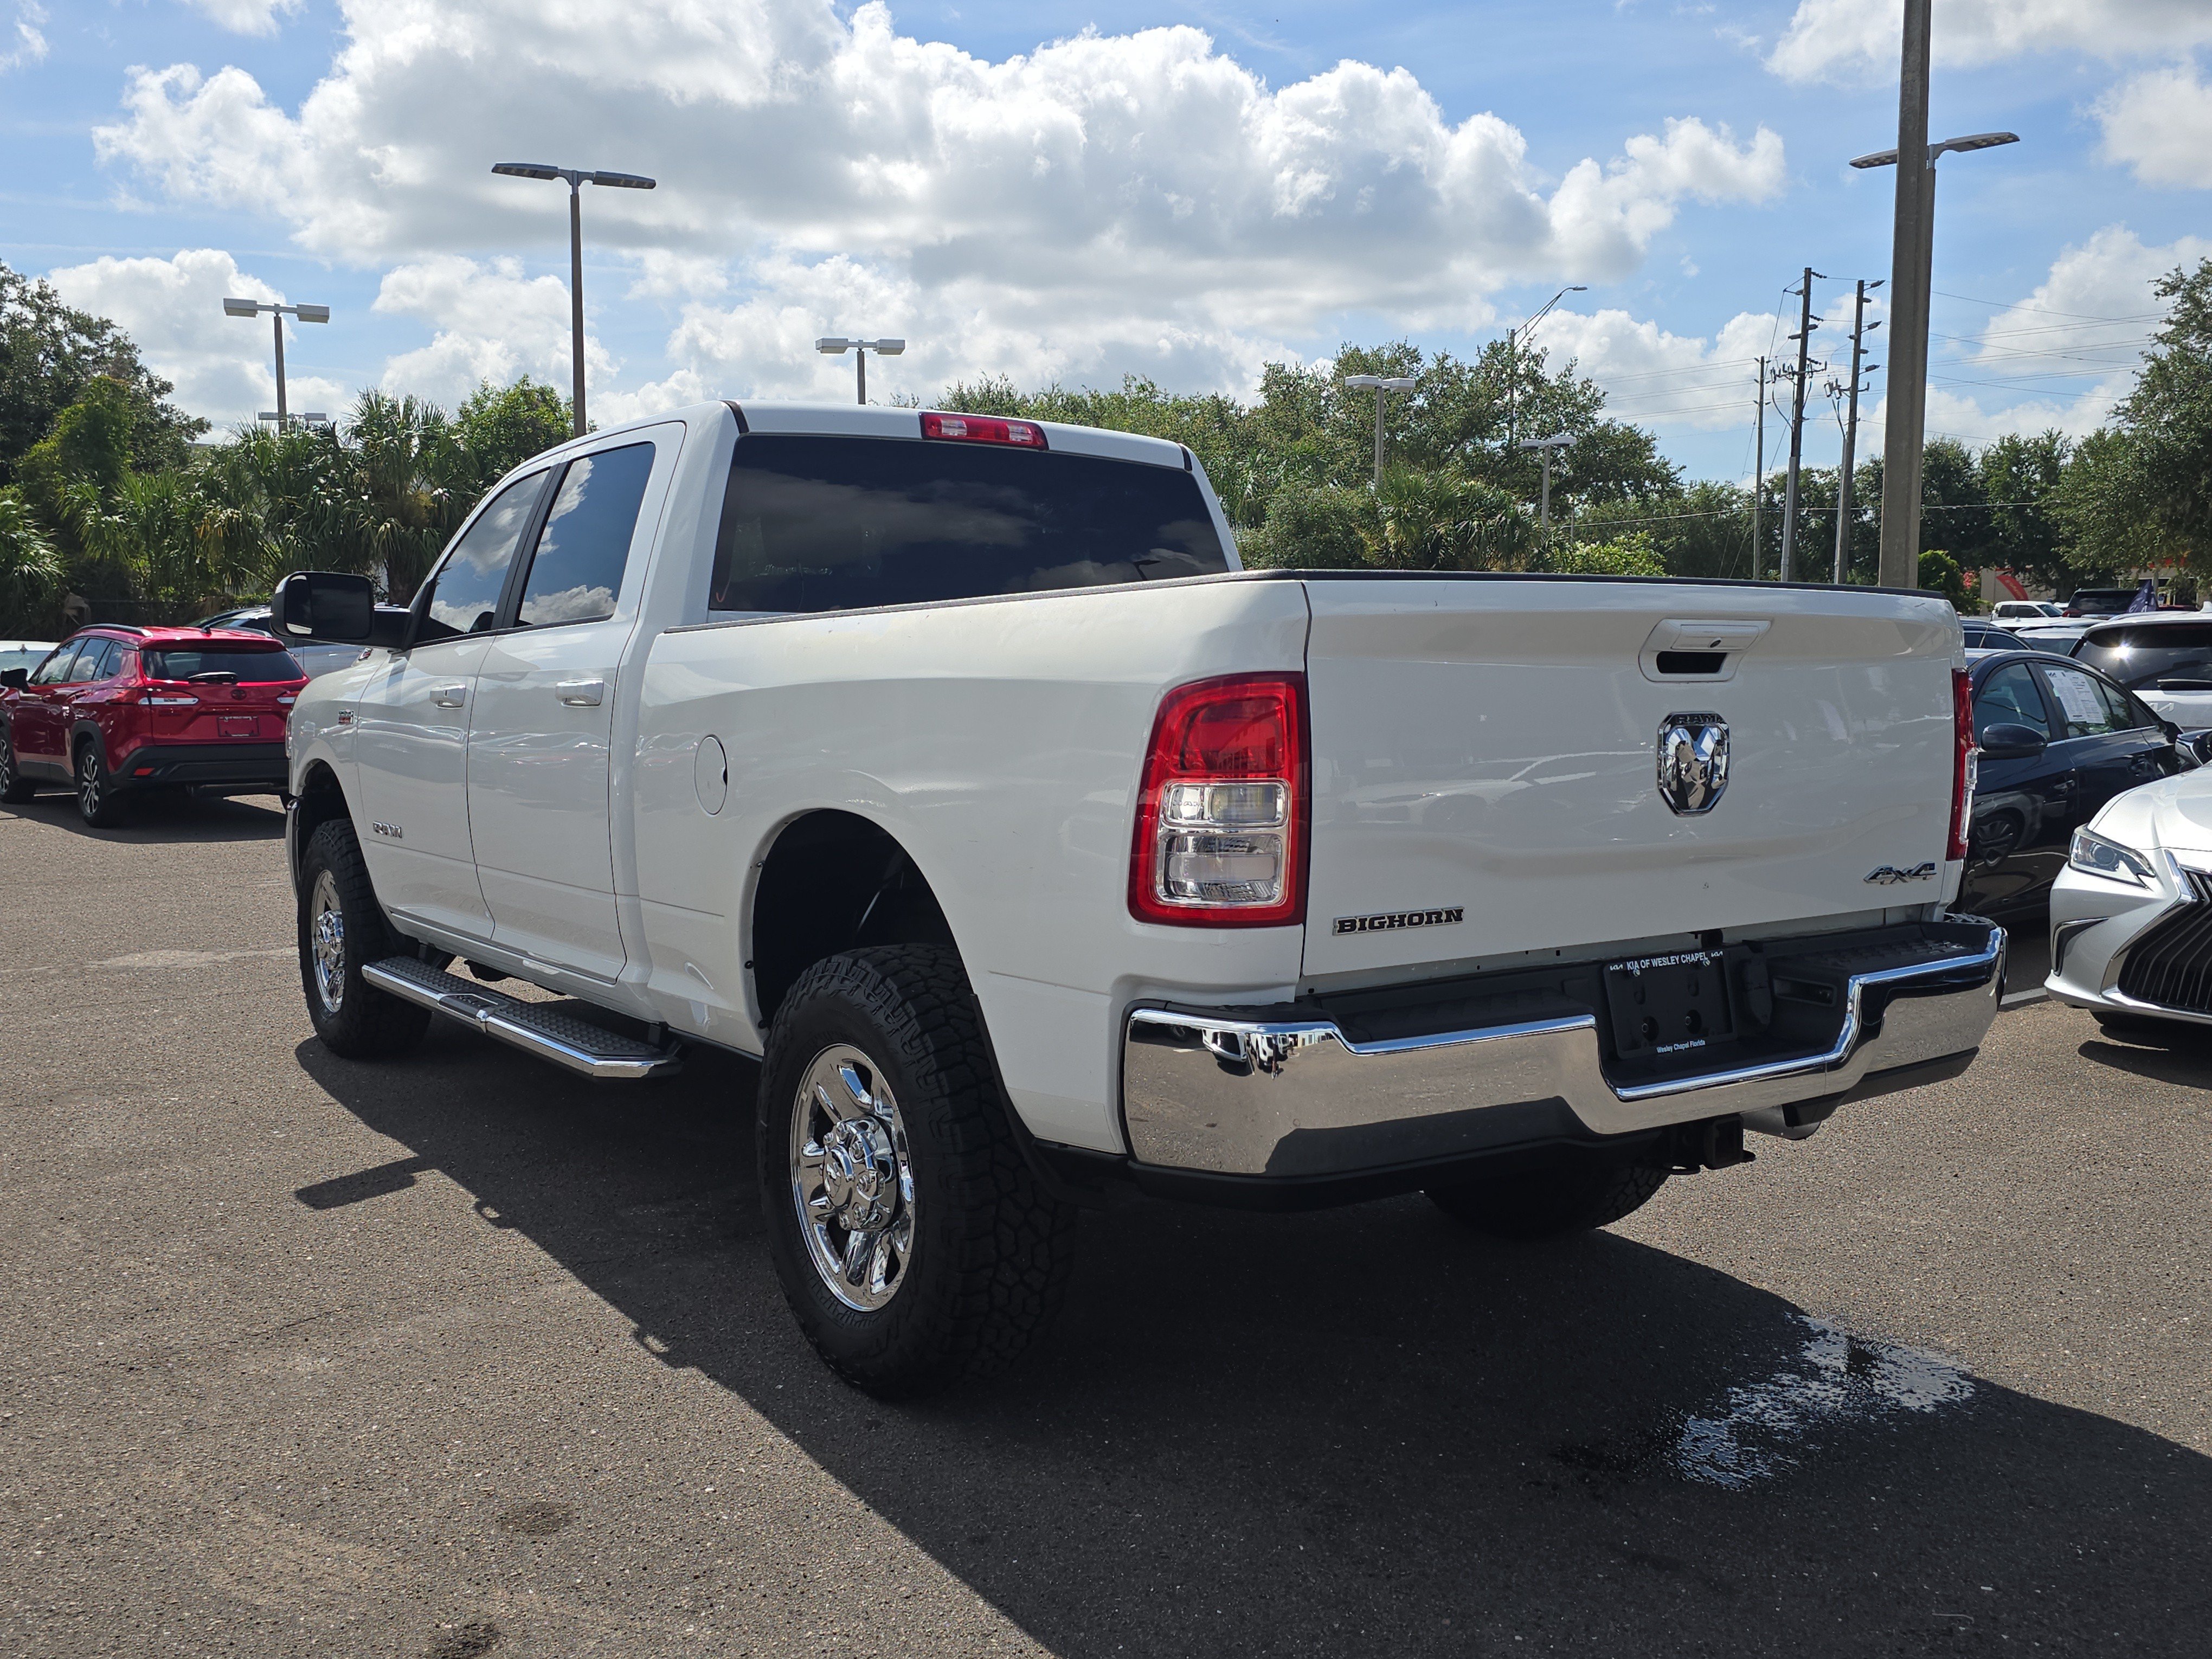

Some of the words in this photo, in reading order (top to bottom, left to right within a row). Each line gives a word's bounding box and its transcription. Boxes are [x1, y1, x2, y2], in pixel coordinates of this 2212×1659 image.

[1676, 715, 1718, 724] RAM
[372, 821, 402, 839] RAM
[1333, 906, 1464, 935] BIGHORN
[1626, 961, 1640, 970] KIA
[1640, 959, 1650, 968] OF
[1651, 955, 1679, 967] WESLEY
[1681, 952, 1708, 963] CHAPEL
[1674, 1041, 1689, 1050] Chapel
[1690, 1039, 1706, 1047] Florida
